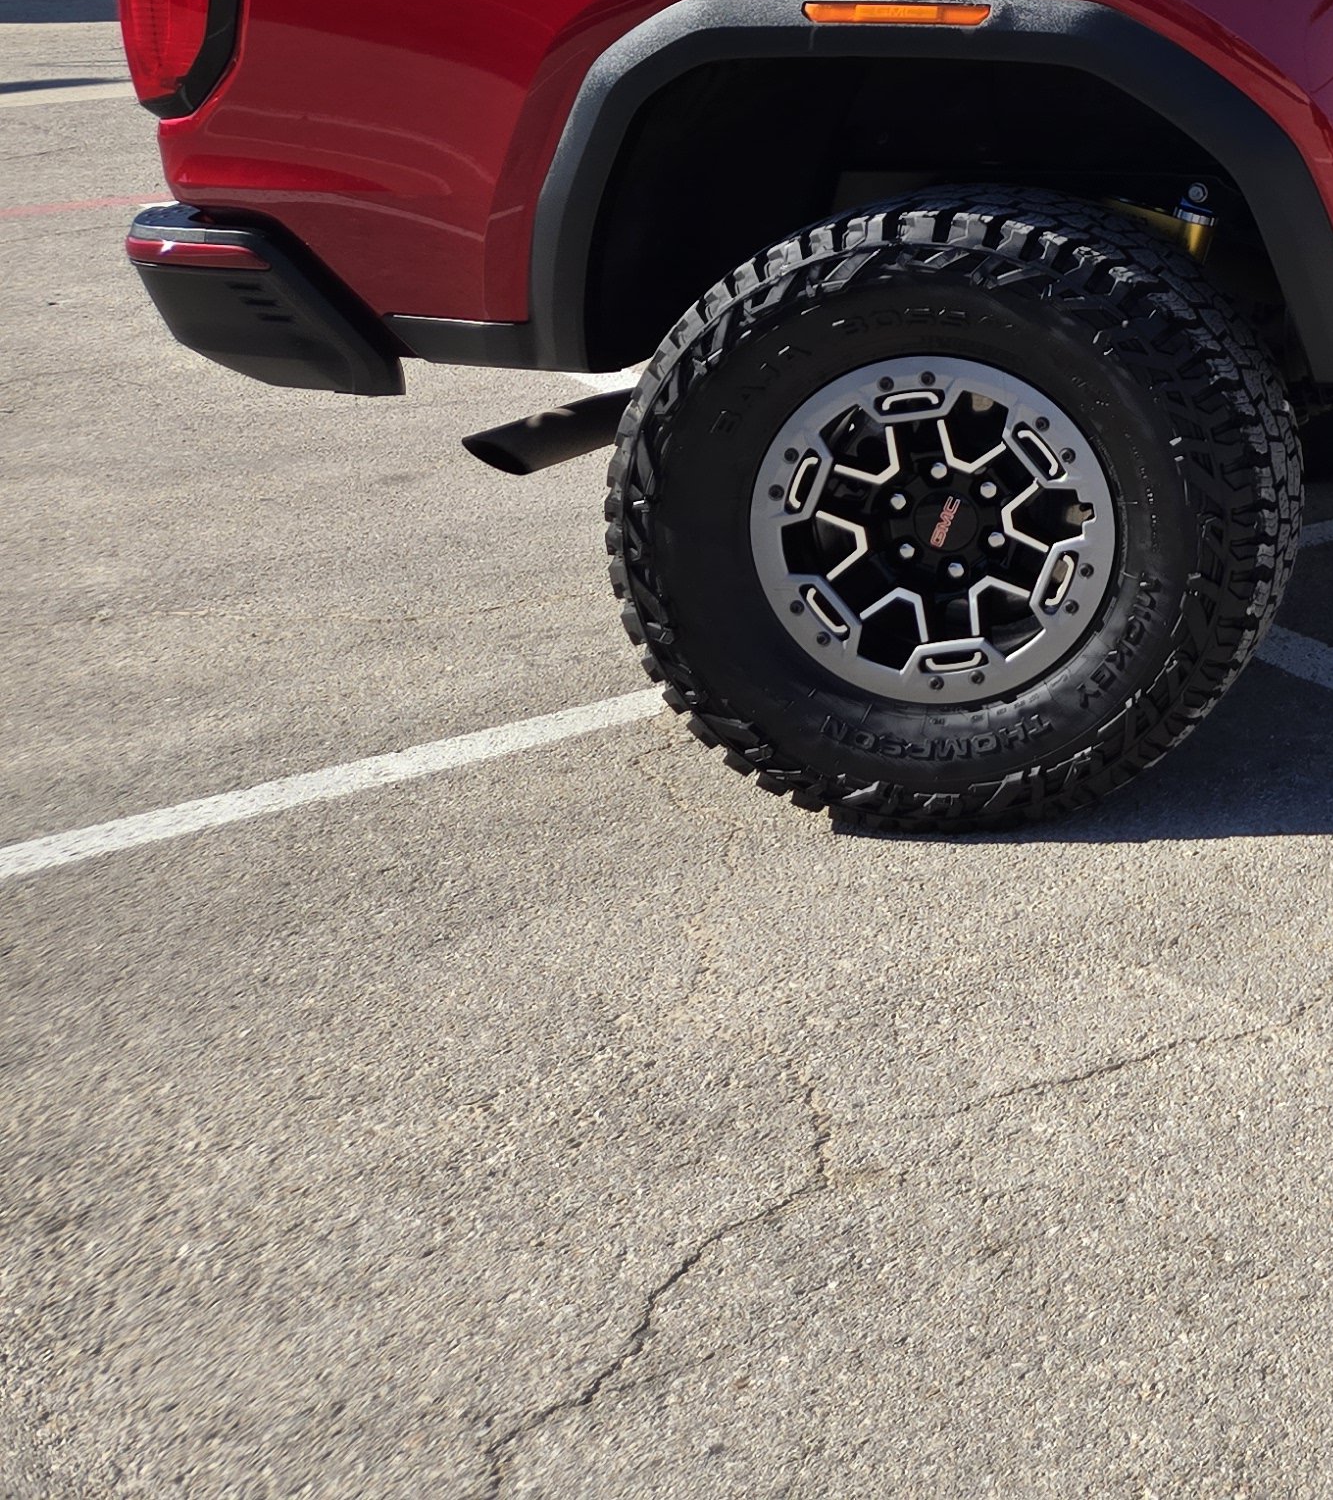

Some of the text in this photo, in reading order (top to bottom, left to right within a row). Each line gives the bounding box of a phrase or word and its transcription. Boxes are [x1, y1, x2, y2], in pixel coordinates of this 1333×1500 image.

[831, 306, 970, 336] BOSS
[931, 496, 961, 549] GMC
[818, 572, 1163, 762] MICKEY THOMPSON
